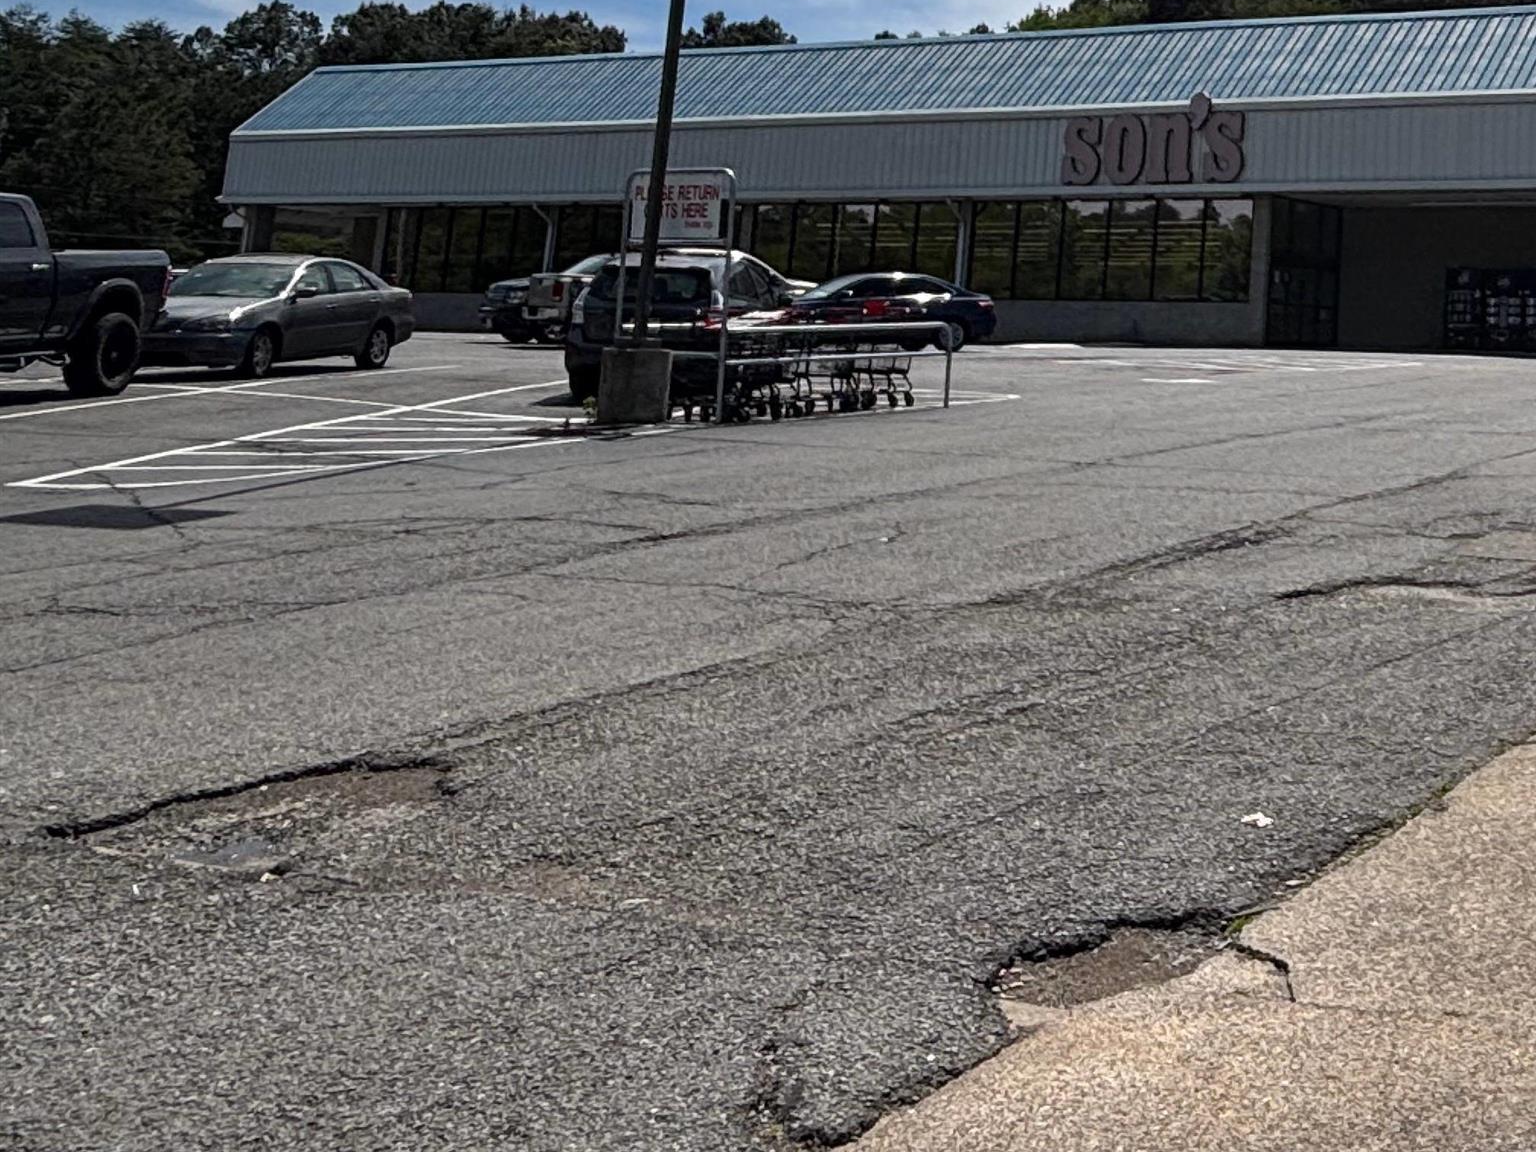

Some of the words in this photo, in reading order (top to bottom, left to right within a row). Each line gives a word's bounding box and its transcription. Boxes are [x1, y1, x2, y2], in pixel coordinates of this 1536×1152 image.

[634, 184, 675, 201] PLSE
[677, 183, 720, 201] RETURN
[681, 202, 709, 218] HERE
